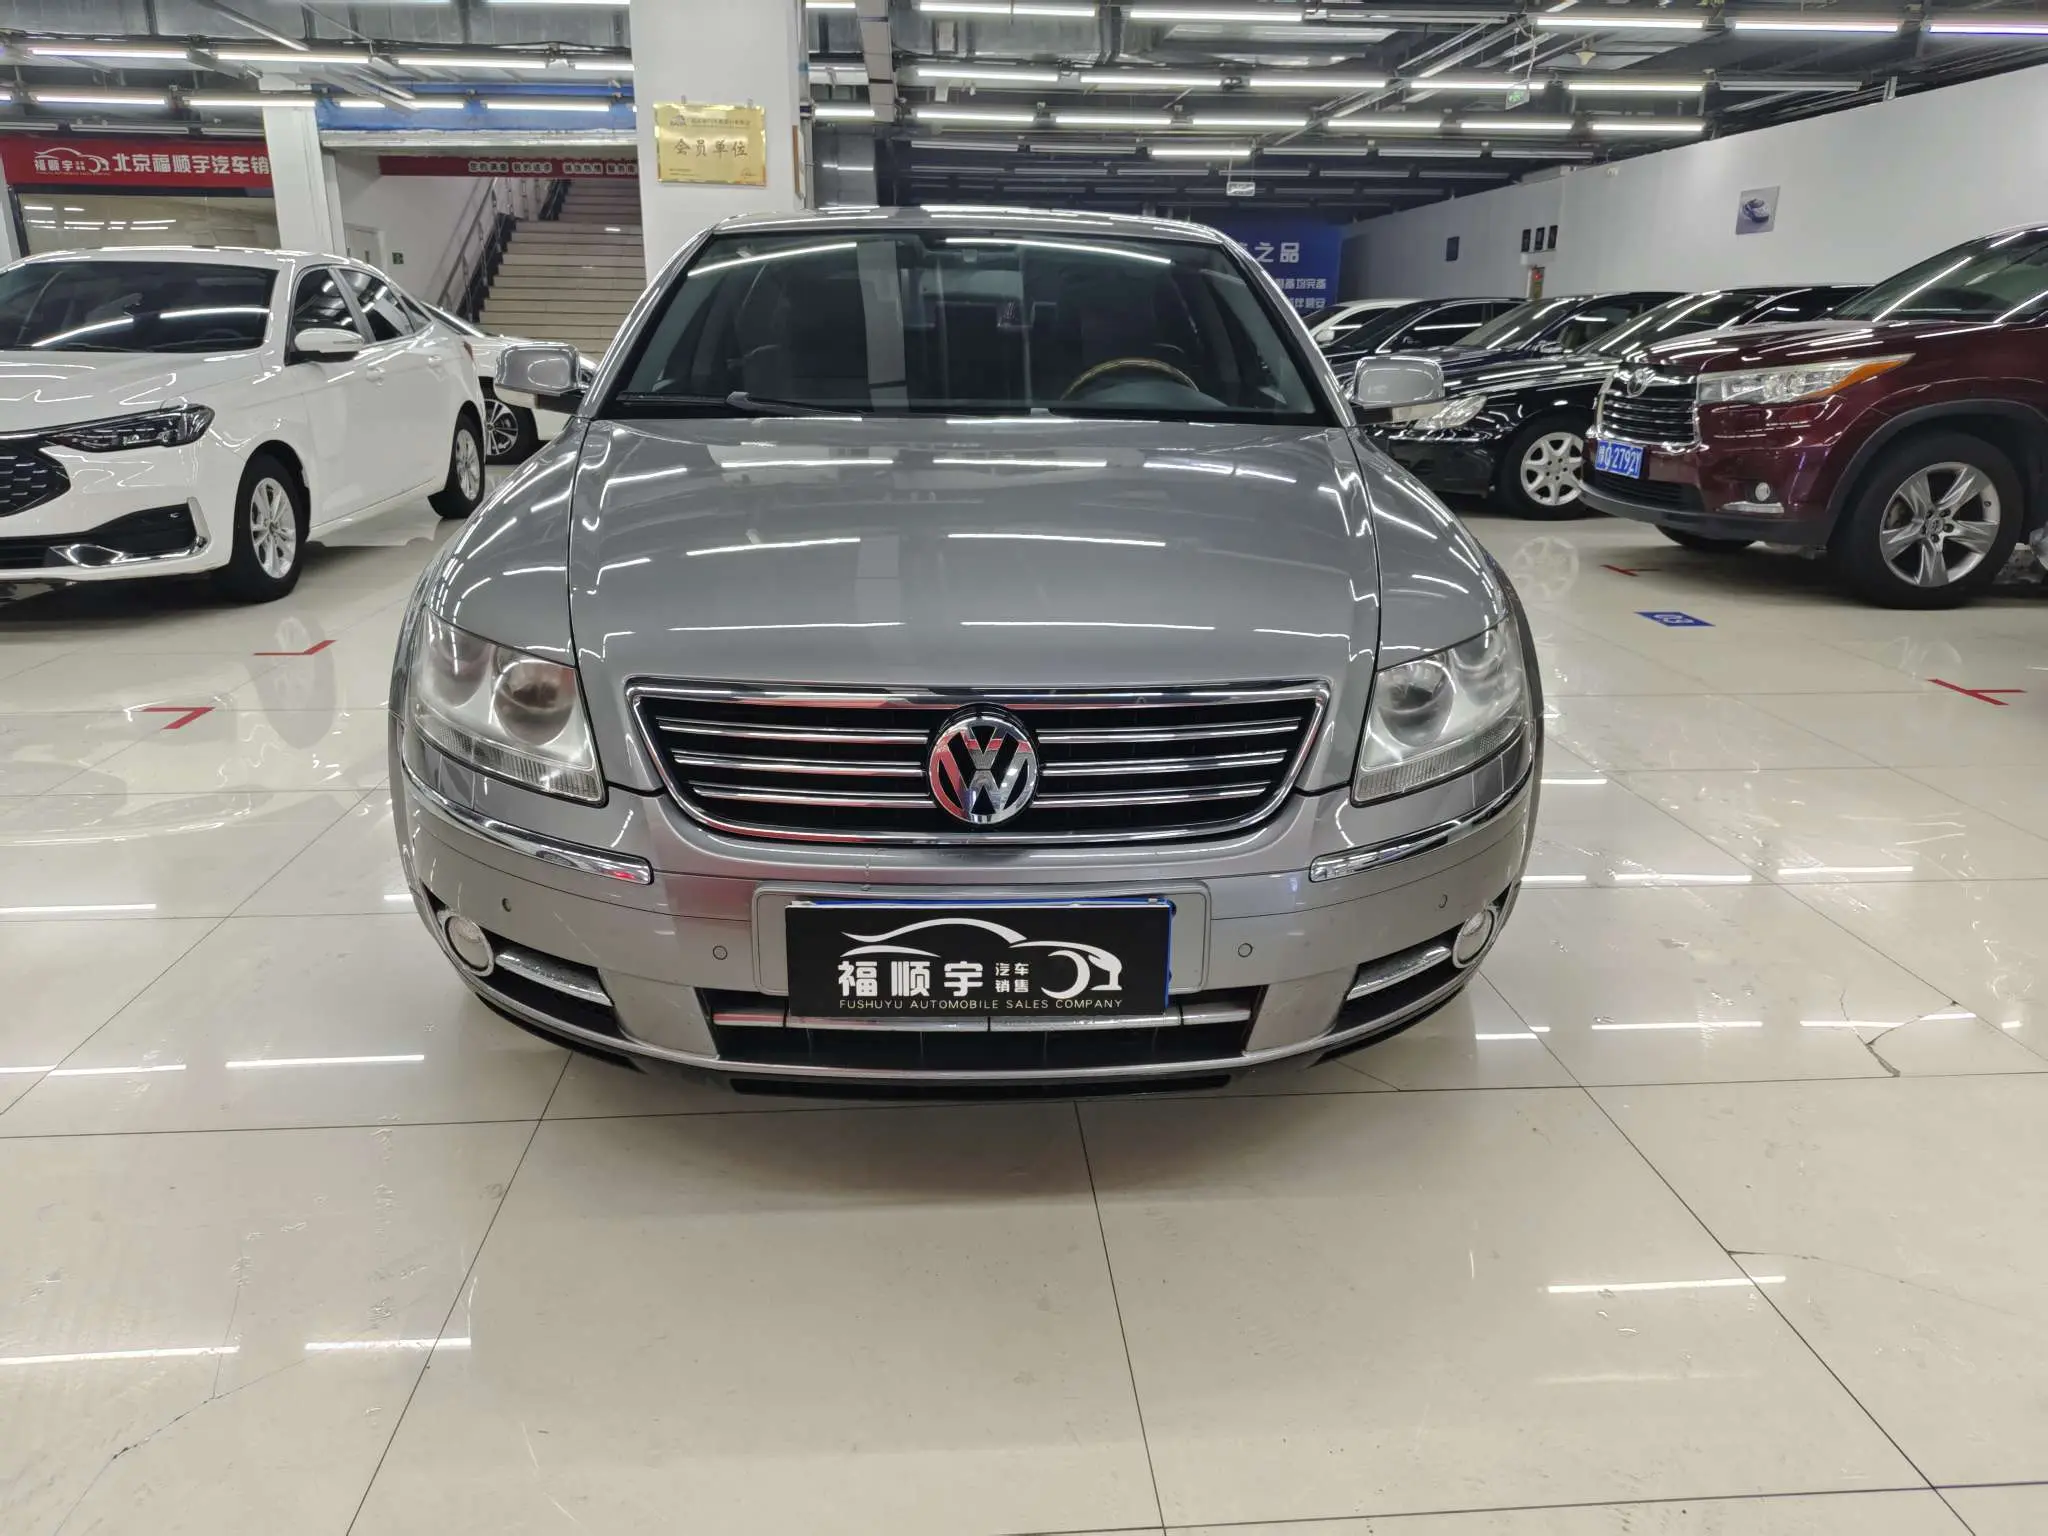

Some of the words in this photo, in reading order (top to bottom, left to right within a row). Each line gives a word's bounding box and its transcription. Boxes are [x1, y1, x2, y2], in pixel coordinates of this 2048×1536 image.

[673, 138, 748, 158] 会员单位
[1240, 242, 1299, 263] 之品
[995, 962, 1029, 976] 汽车
[995, 979, 1029, 993] 销售
[839, 1000, 903, 1009] FUSHUYU
[910, 1000, 999, 1009] AUTOMOBILE
[1006, 1000, 1049, 1009] SALES
[1055, 1000, 1122, 1009] COMPANY
